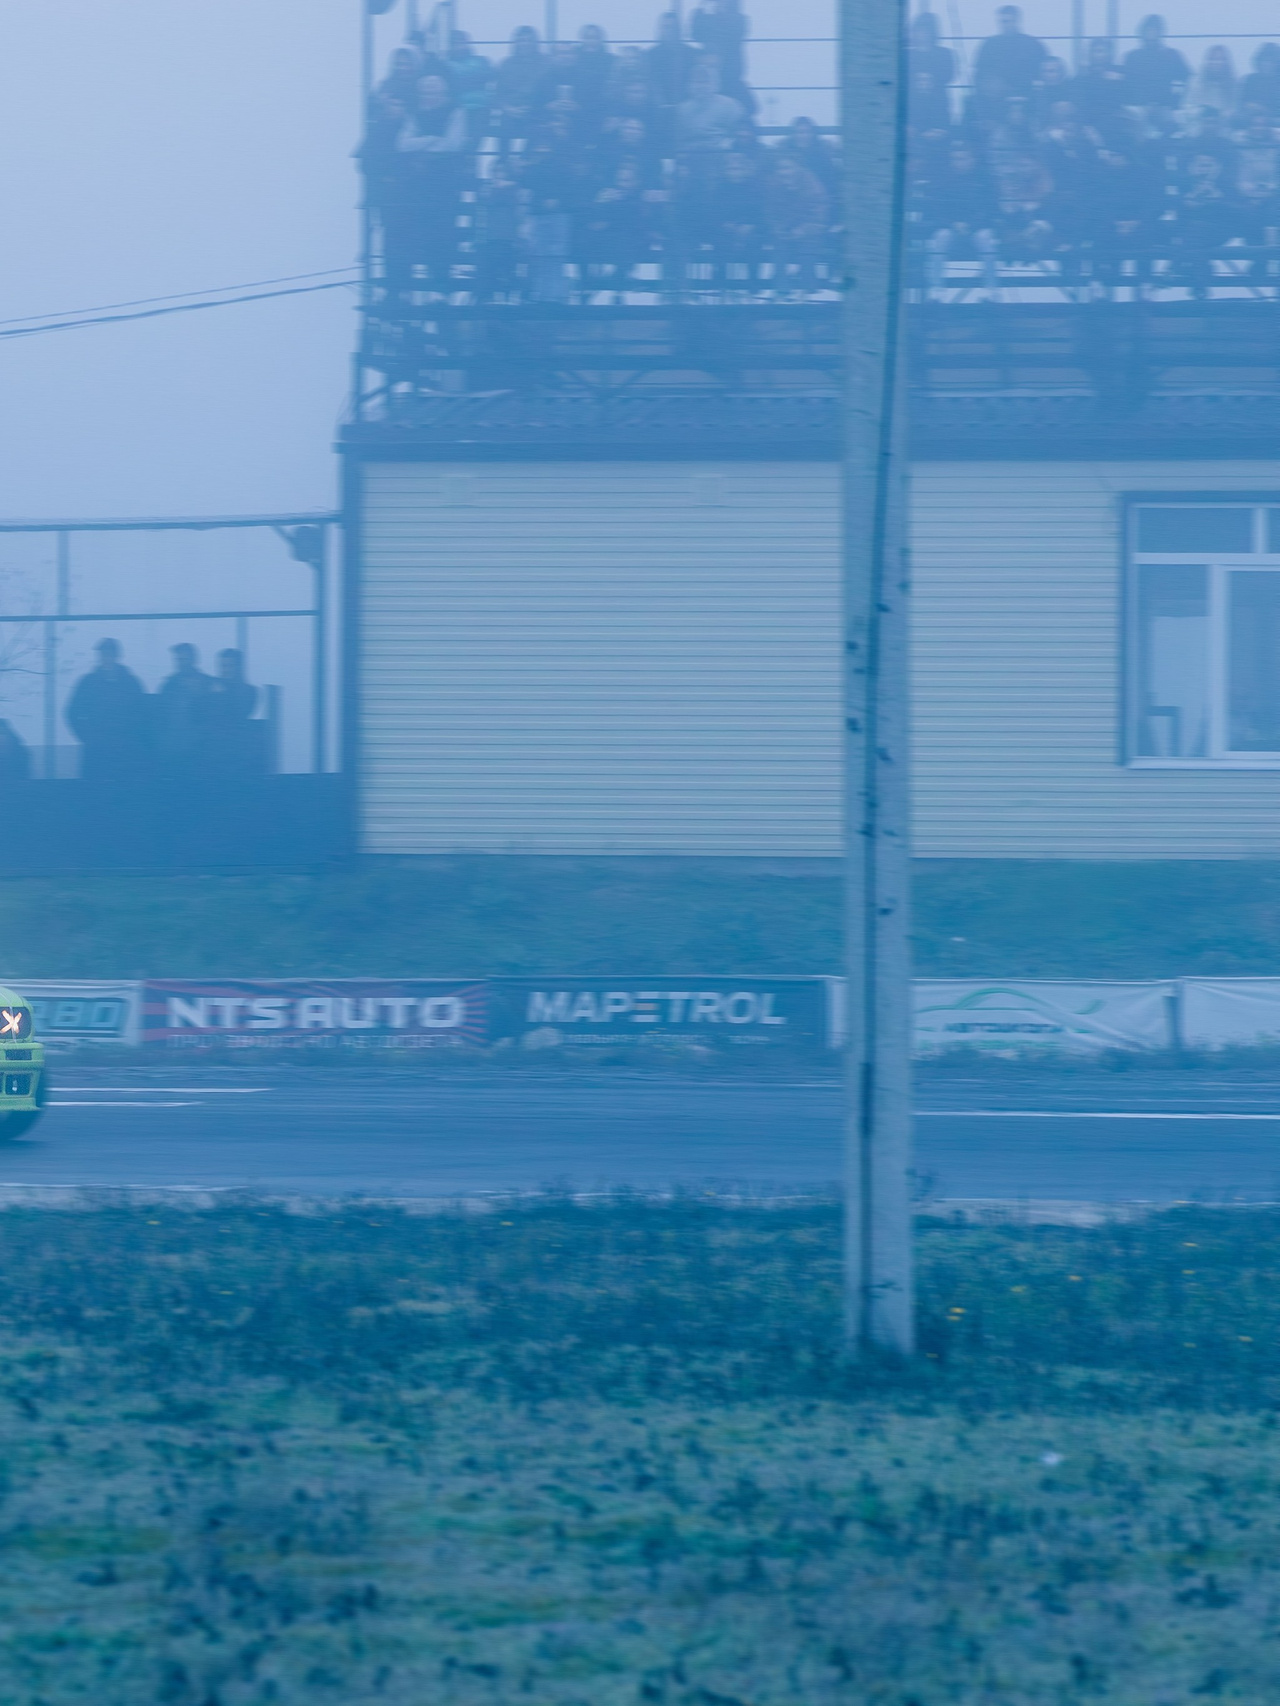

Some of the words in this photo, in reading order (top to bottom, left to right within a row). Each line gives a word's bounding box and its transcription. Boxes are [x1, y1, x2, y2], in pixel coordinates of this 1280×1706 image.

[166, 997, 291, 1029] NTS
[297, 997, 465, 1029] AUTO
[525, 991, 788, 1024] MAPETROL
